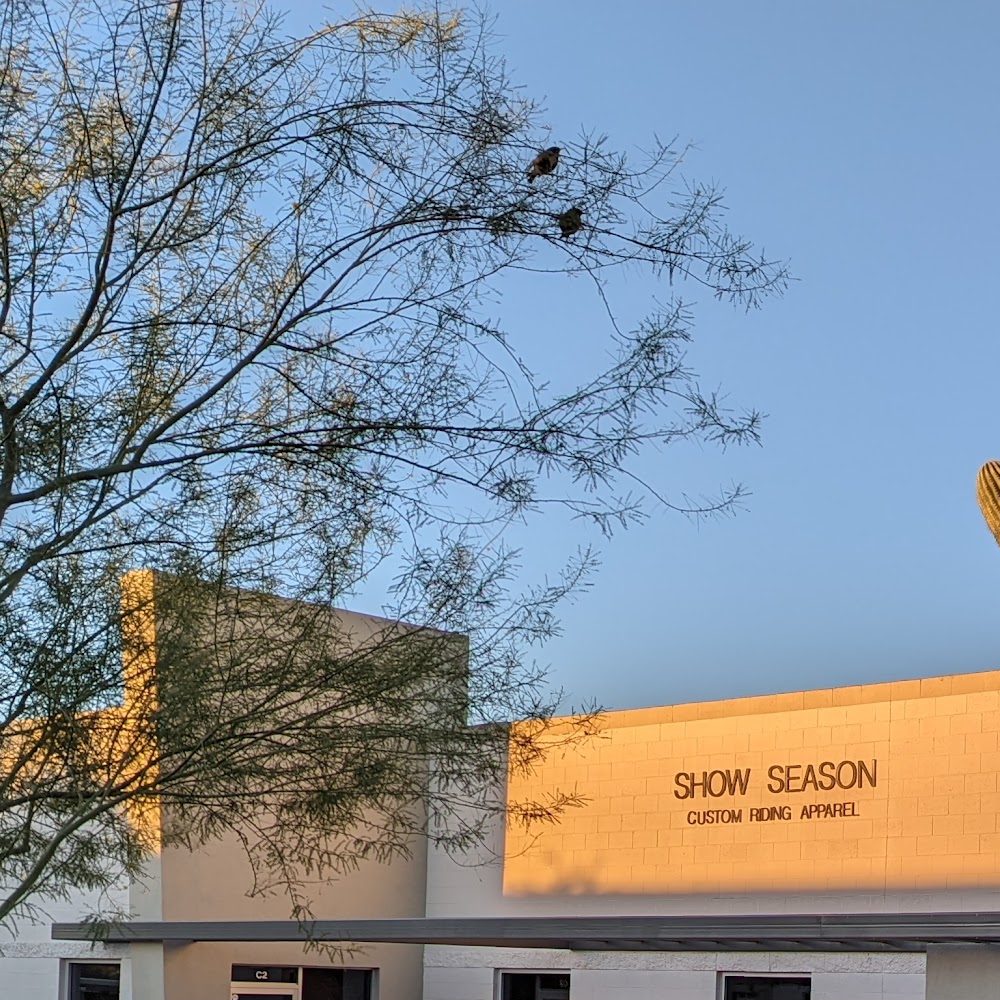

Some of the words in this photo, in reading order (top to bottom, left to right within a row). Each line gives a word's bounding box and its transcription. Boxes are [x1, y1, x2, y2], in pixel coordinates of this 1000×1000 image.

[674, 768, 751, 799] SHOW
[767, 759, 877, 793] SEASON
[687, 809, 742, 825] CUSTOM
[749, 806, 791, 822] RIDING
[800, 802, 860, 819] APPAREL
[255, 970, 268, 980] C2
